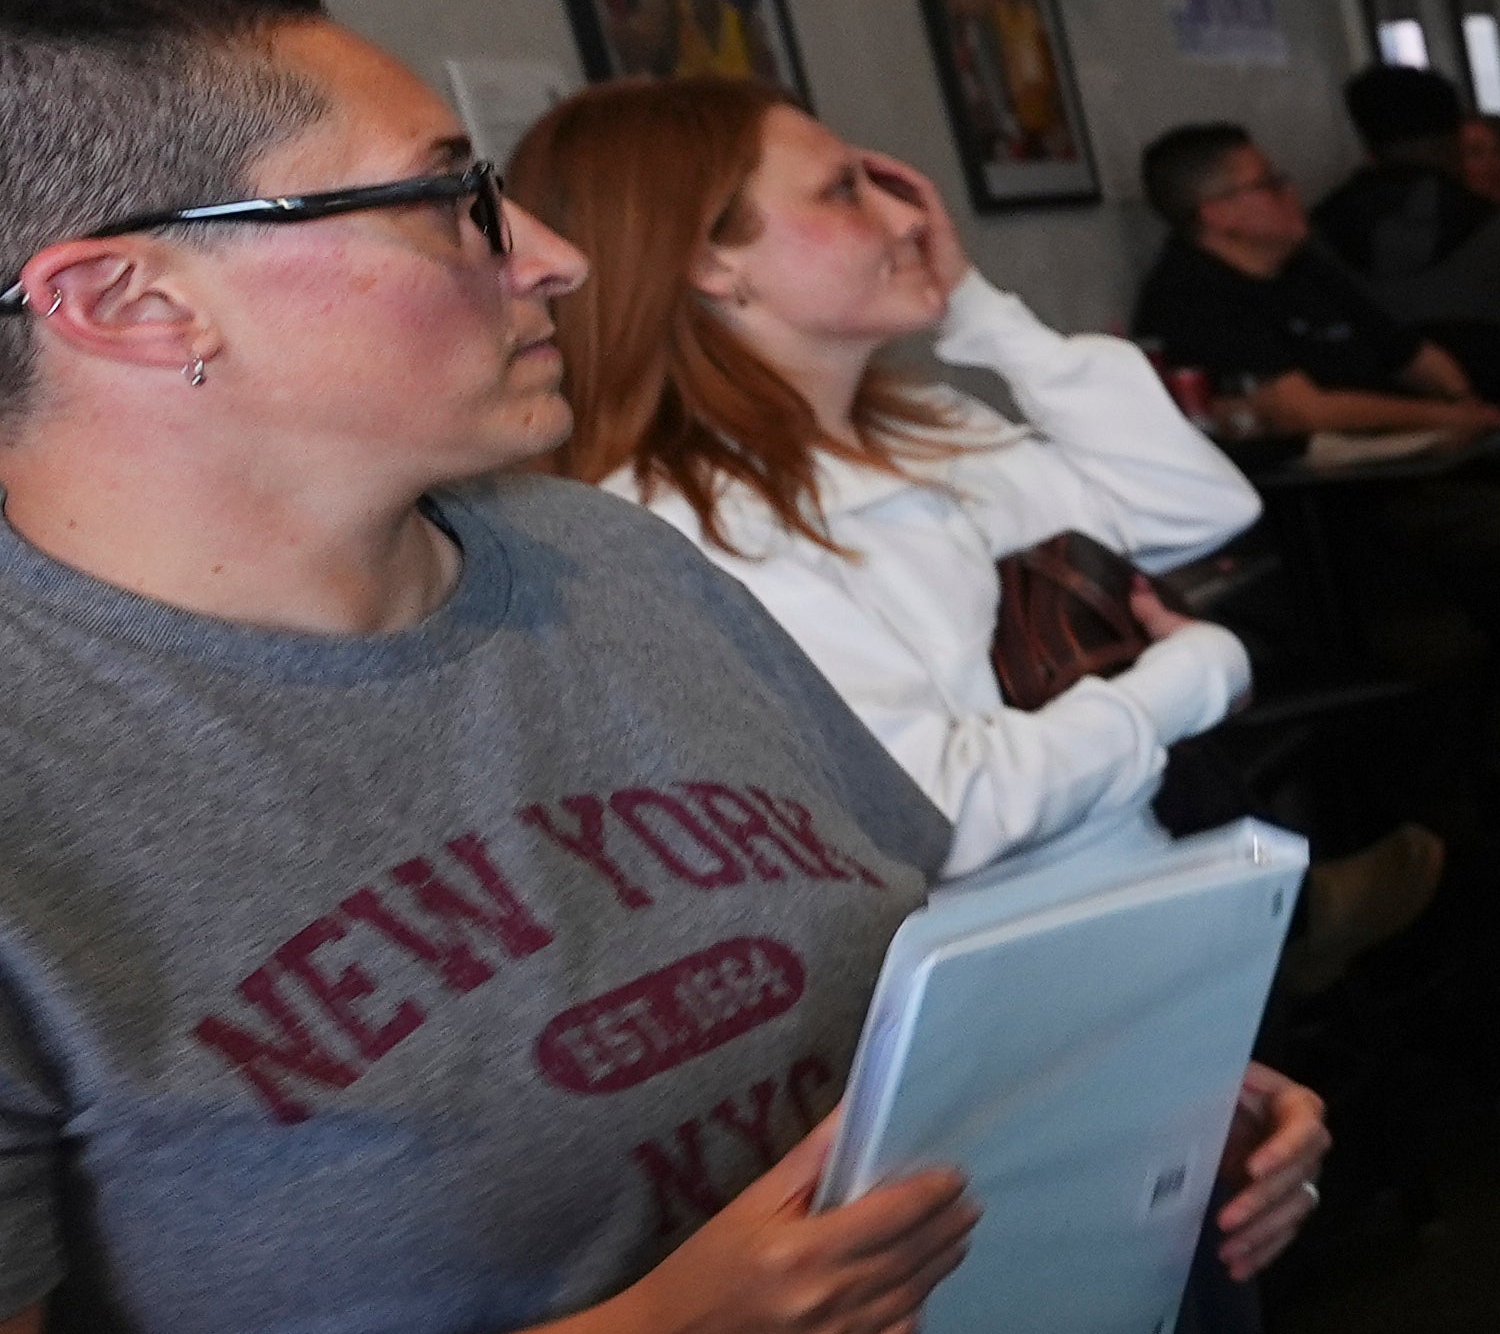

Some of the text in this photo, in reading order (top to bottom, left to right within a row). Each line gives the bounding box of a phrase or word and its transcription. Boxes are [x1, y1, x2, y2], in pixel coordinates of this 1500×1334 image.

[195, 780, 890, 1127] NEW YORK
[553, 995, 692, 1085] EST.
